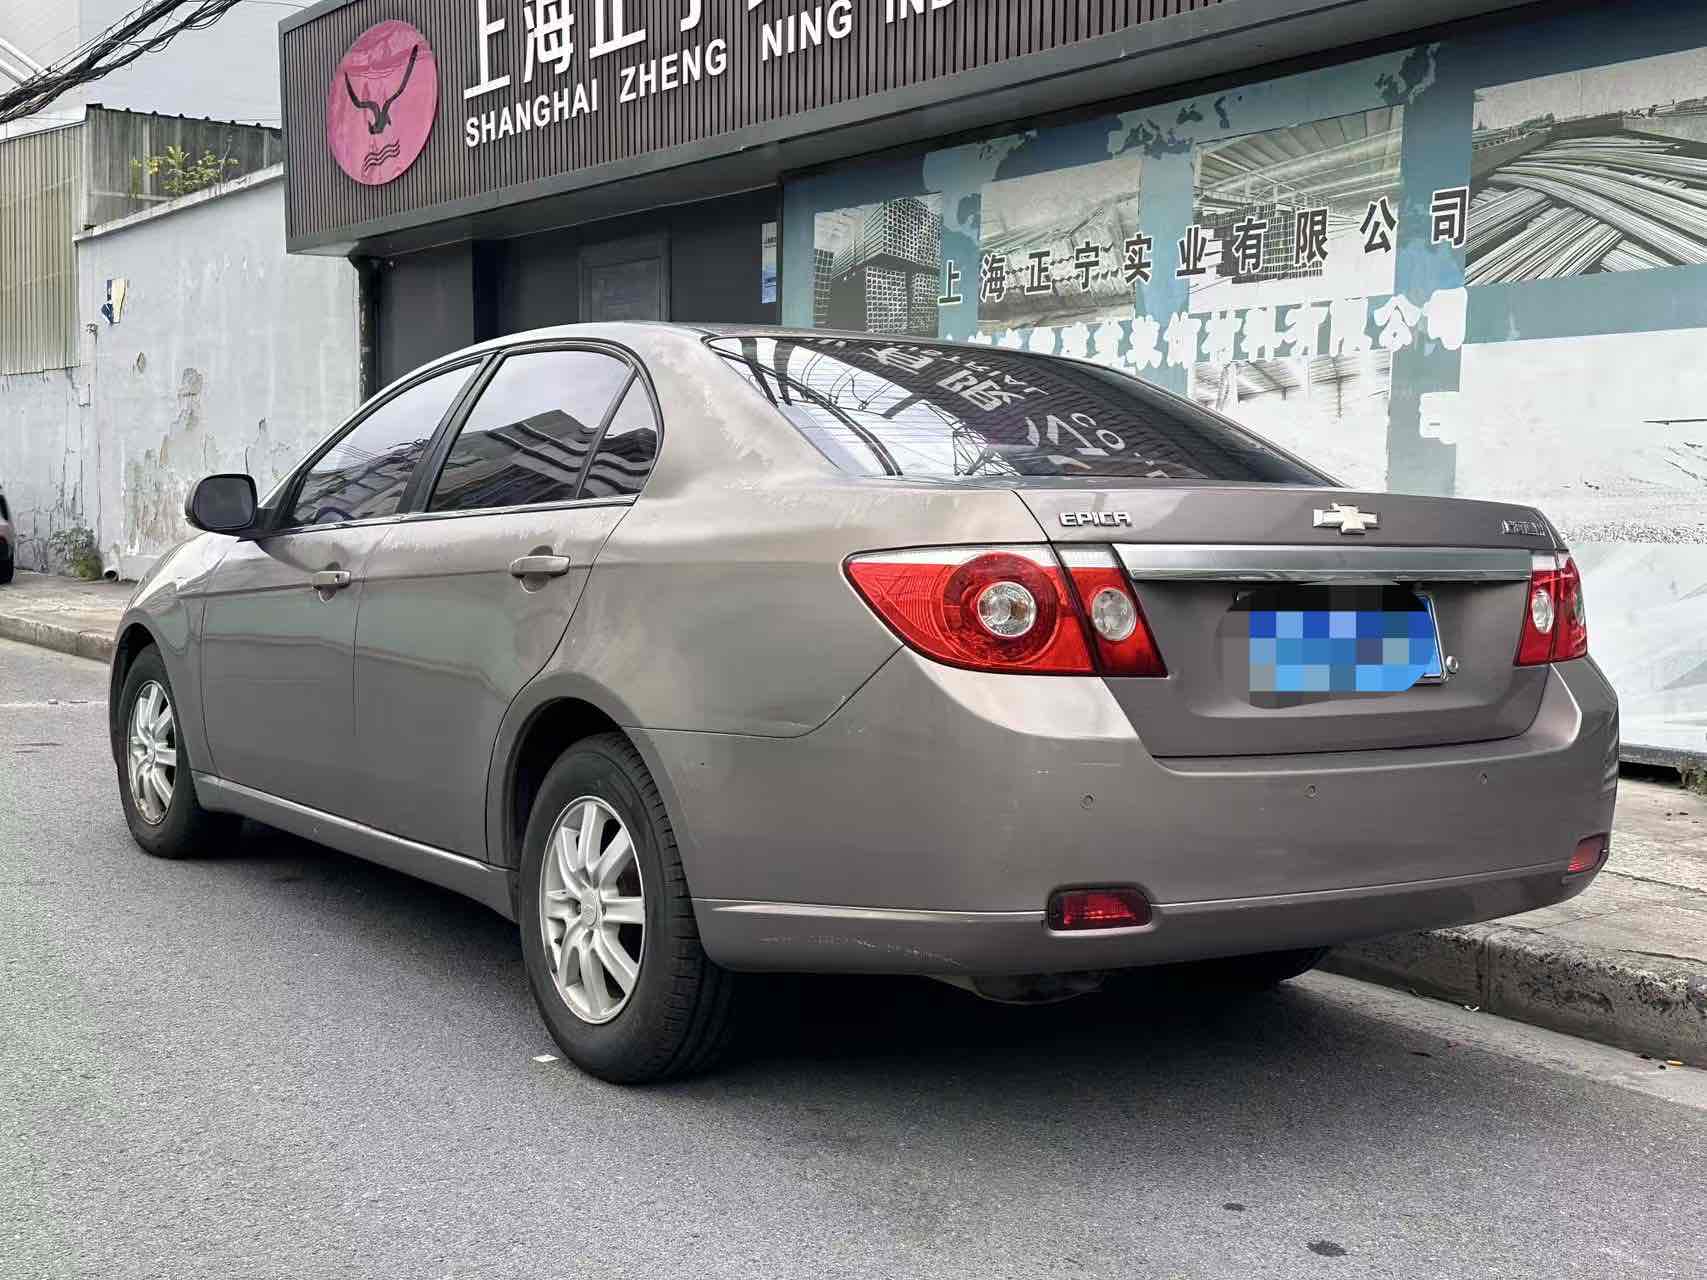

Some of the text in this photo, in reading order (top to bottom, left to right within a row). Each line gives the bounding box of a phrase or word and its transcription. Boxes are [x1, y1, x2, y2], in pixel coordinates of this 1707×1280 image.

[465, 78, 598, 148] SHANGHAI
[619, 38, 727, 103] ZHENG
[761, 0, 853, 61] NING
[938, 185, 1470, 304] 上海正宁实业有限公司
[1058, 510, 1132, 528] EPICA
